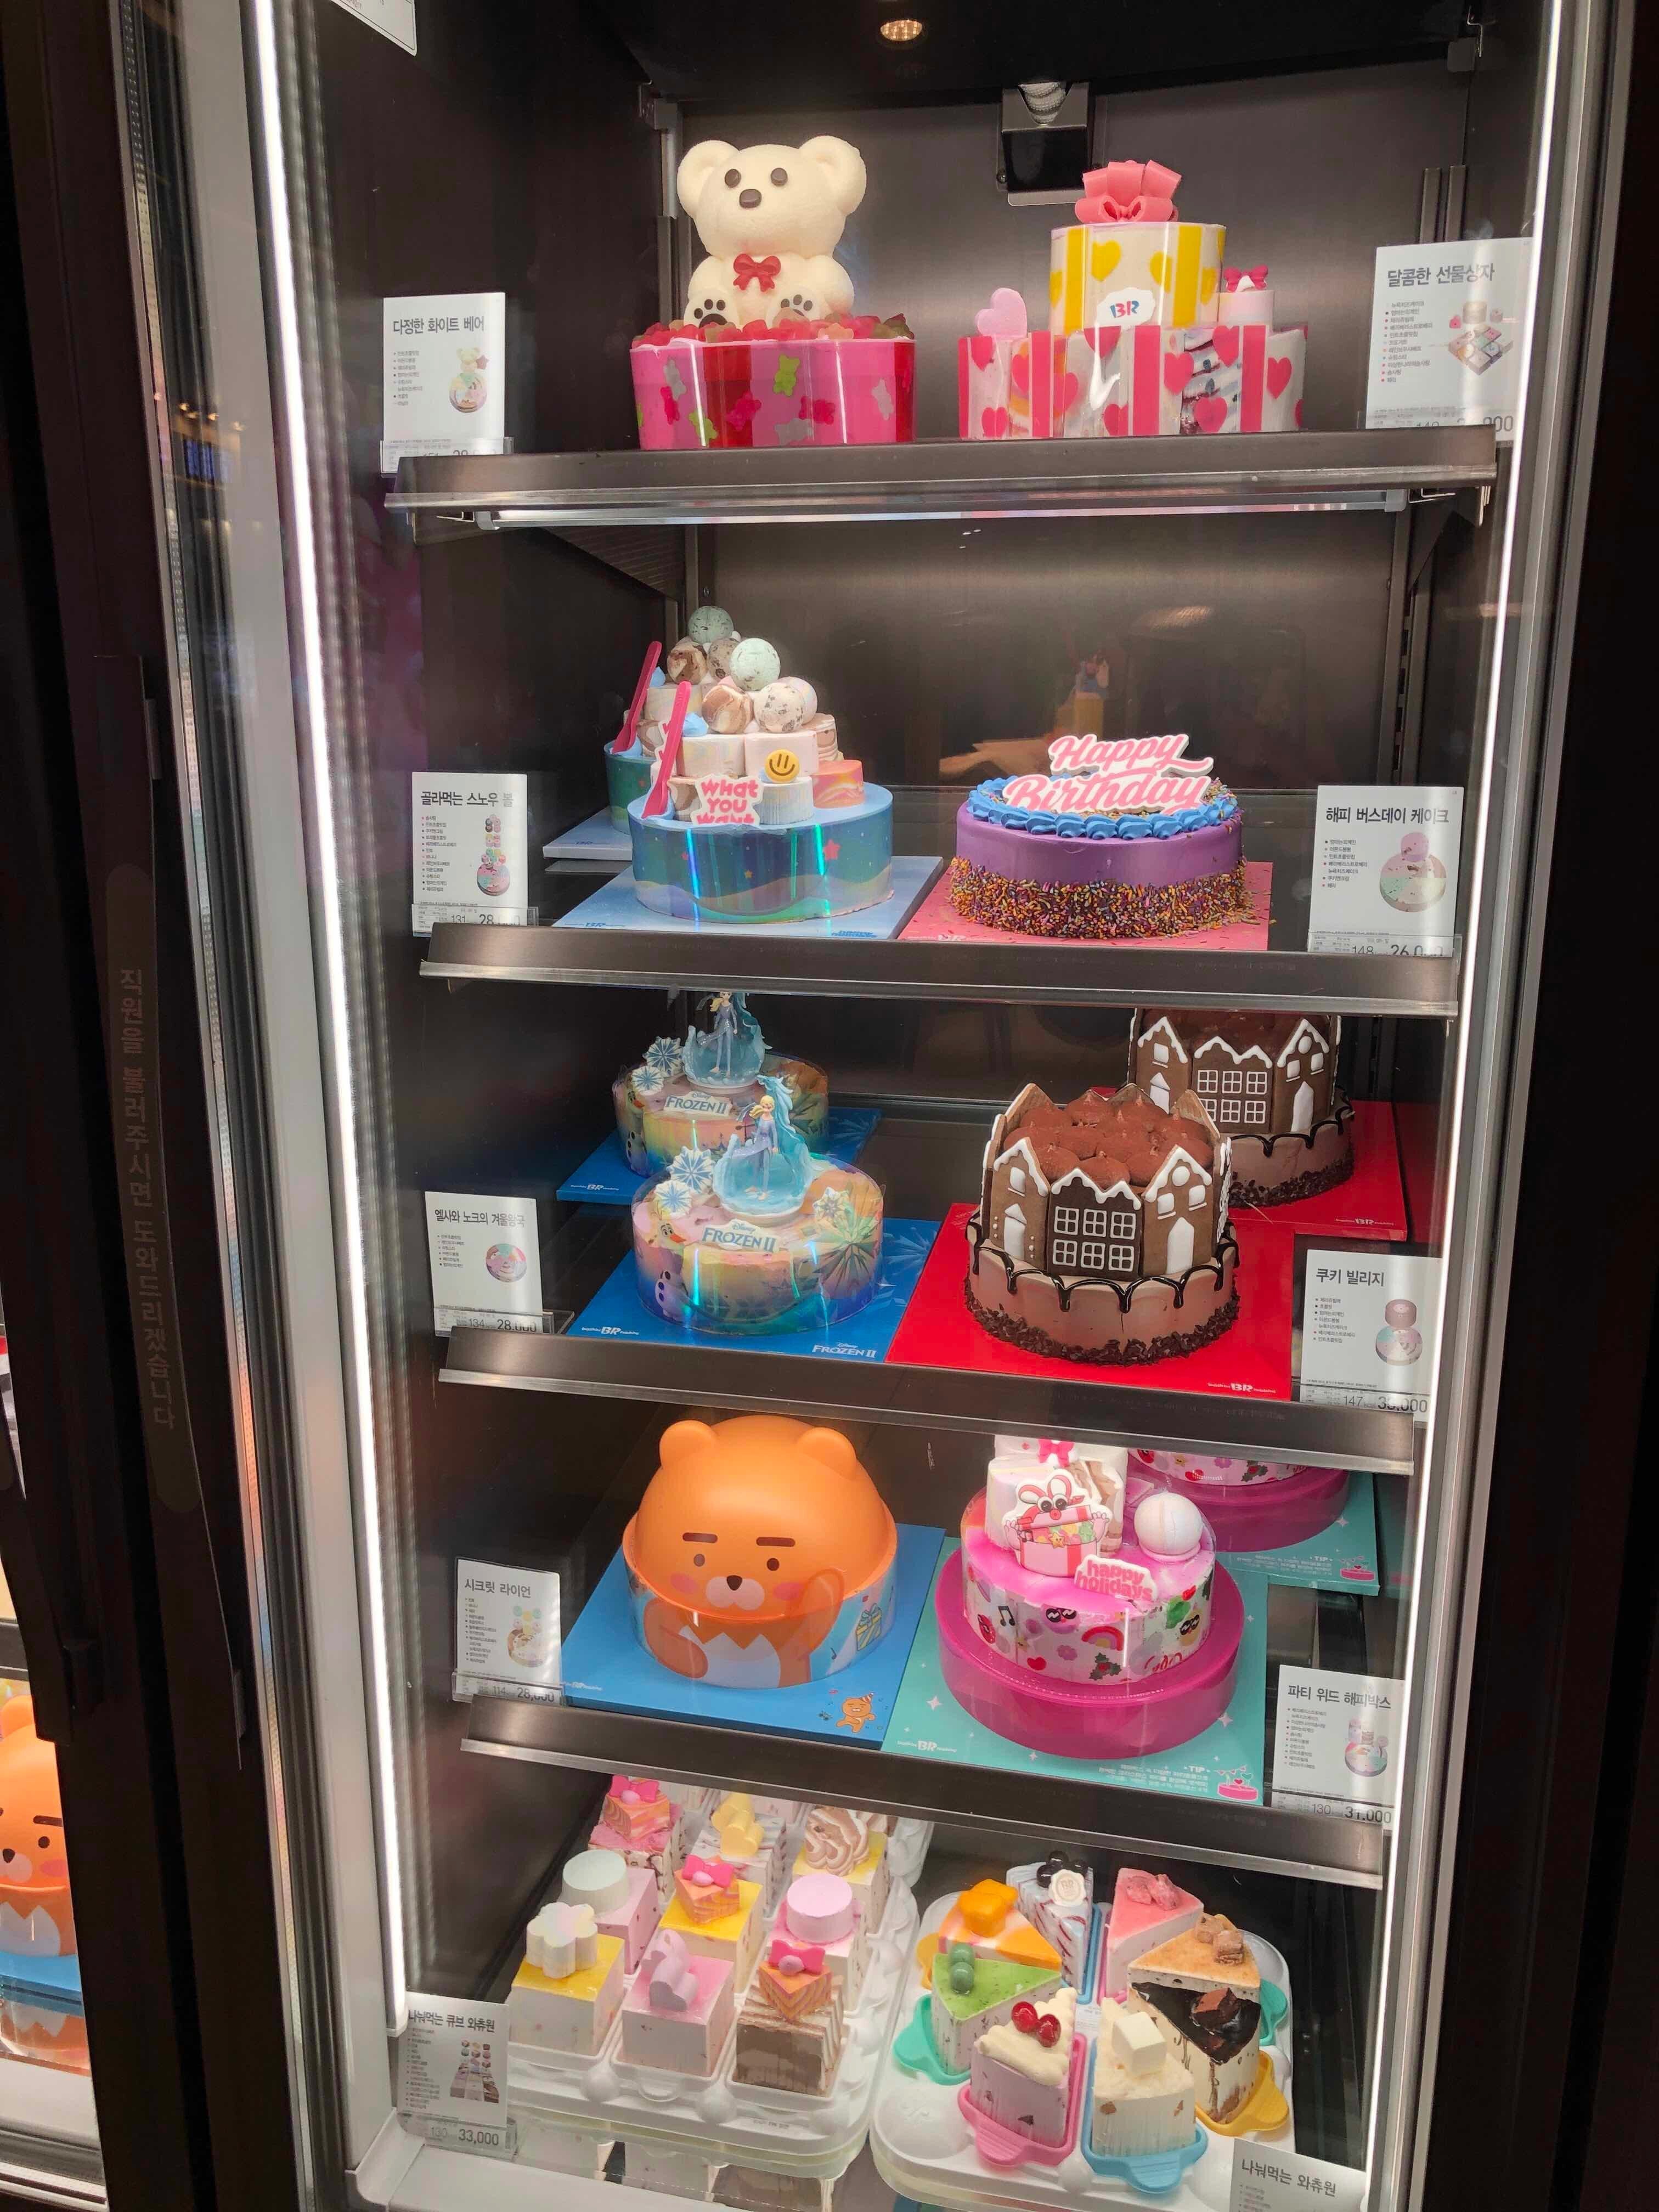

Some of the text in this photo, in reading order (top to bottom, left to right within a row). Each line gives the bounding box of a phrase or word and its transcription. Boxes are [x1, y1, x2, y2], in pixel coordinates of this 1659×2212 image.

[1387, 263, 1495, 288] 달콤한 선물상자
[1110, 300, 1139, 318] BR
[393, 315, 484, 335] 다정한 화이트 베어
[1050, 734, 1211, 770] Happy
[421, 791, 514, 808] 골라먹는 스노우 볼
[1006, 768, 1209, 815] Birthday
[1325, 806, 1449, 825] 해피 버스데이 케이크
[1352, 945, 1374, 955] 148
[666, 1096, 727, 1114] FROZEN II
[119, 968, 176, 1430] 직원을 불러주시면 도와드리겠습니다
[435, 1209, 525, 1228] 엘사와 노크의 겨울왕국
[702, 1227, 777, 1253] FROZEN II
[1316, 1268, 1384, 1286] 쿠키 빌리지
[469, 1318, 485, 1328] 134
[601, 1326, 622, 1335] BR
[812, 1345, 878, 1358] FROZEN II
[1231, 1383, 1254, 1392] BR
[1343, 1395, 1363, 1407] 147
[1087, 1559, 1145, 1585] happy
[465, 1578, 531, 1598] 시크릿 라이언
[1076, 1570, 1153, 1601] holidays
[1288, 1685, 1392, 1709] 파티 위드 해피박스
[918, 1740, 938, 1752] BR
[1312, 1803, 1331, 1815] 130
[408, 2010, 495, 2033] 나눠먹는 큐브 와츄원
[458, 2129, 499, 2146] 33,000
[1242, 2159, 1336, 2197] 나눠먹는 와츄원
